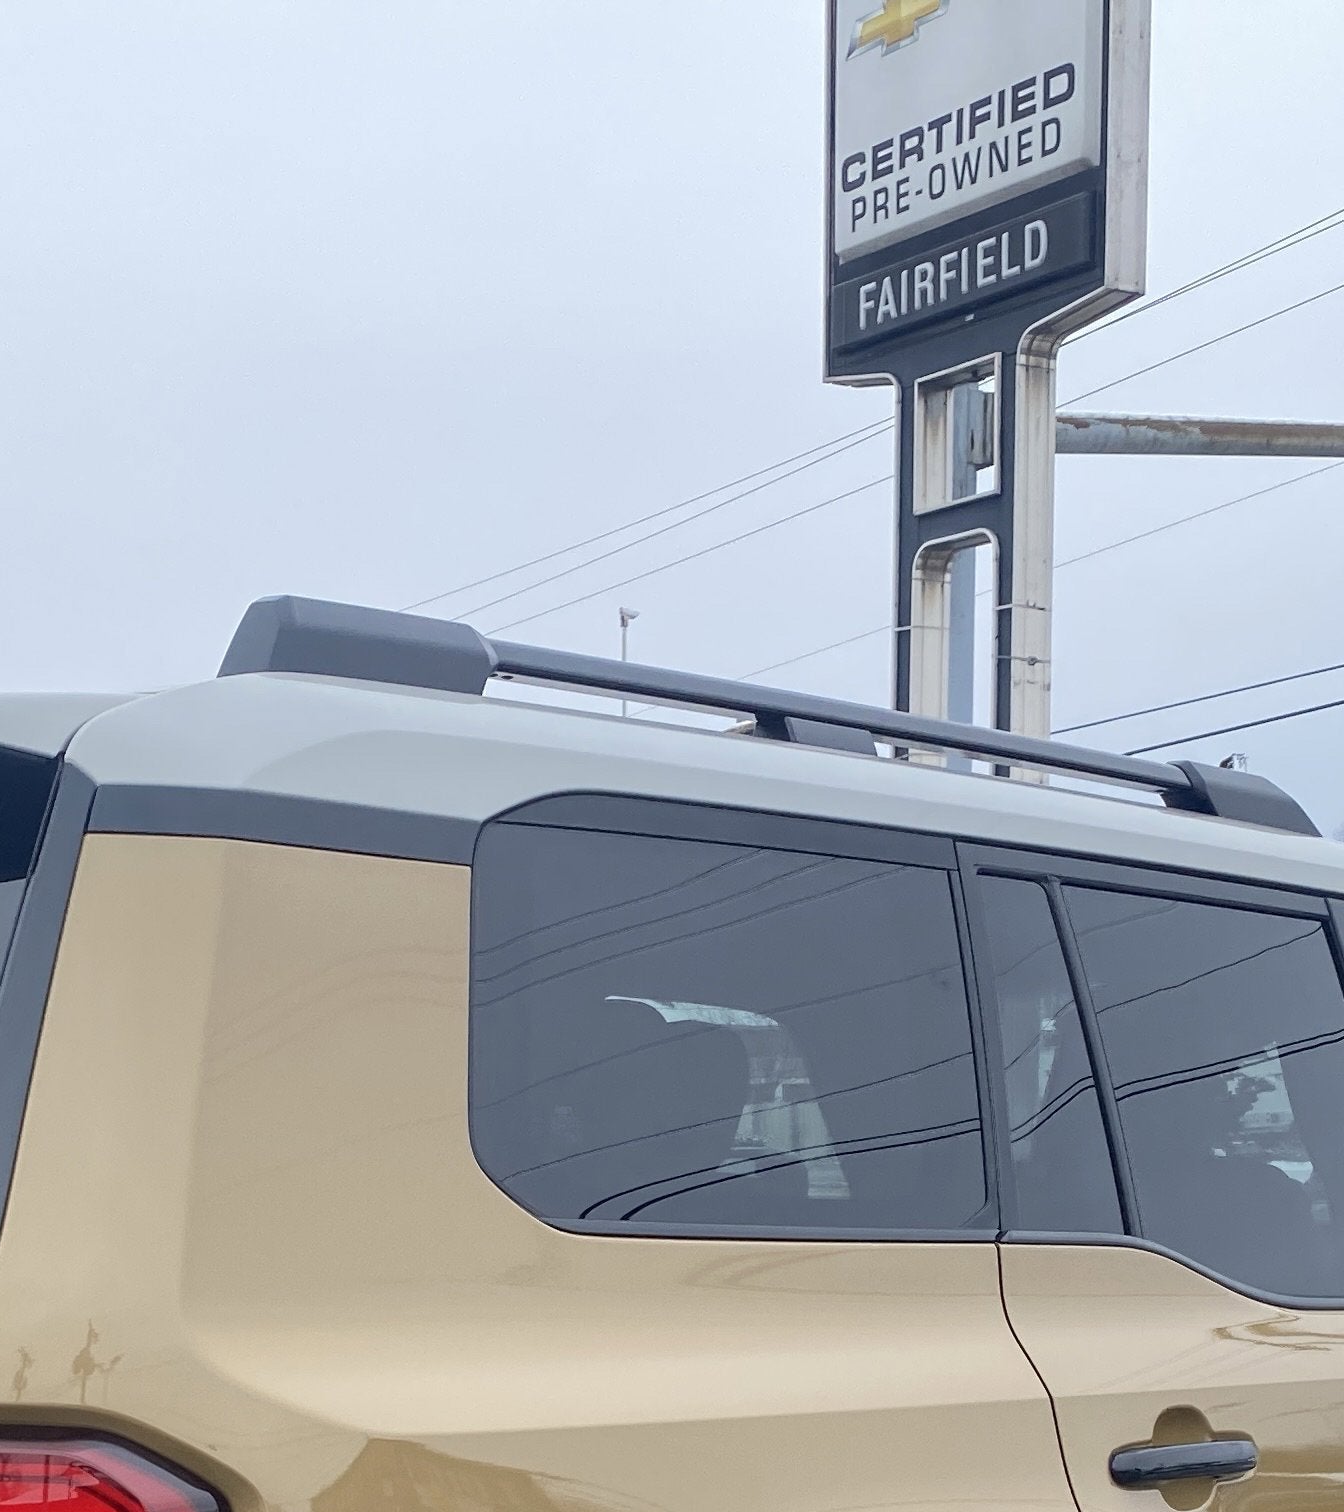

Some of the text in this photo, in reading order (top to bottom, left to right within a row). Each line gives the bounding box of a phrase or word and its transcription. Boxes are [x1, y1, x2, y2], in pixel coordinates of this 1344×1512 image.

[841, 62, 1076, 193] CERTIFIED
[851, 117, 1062, 233] PRE-OWNED
[858, 219, 1049, 331] FAIRFIELD
